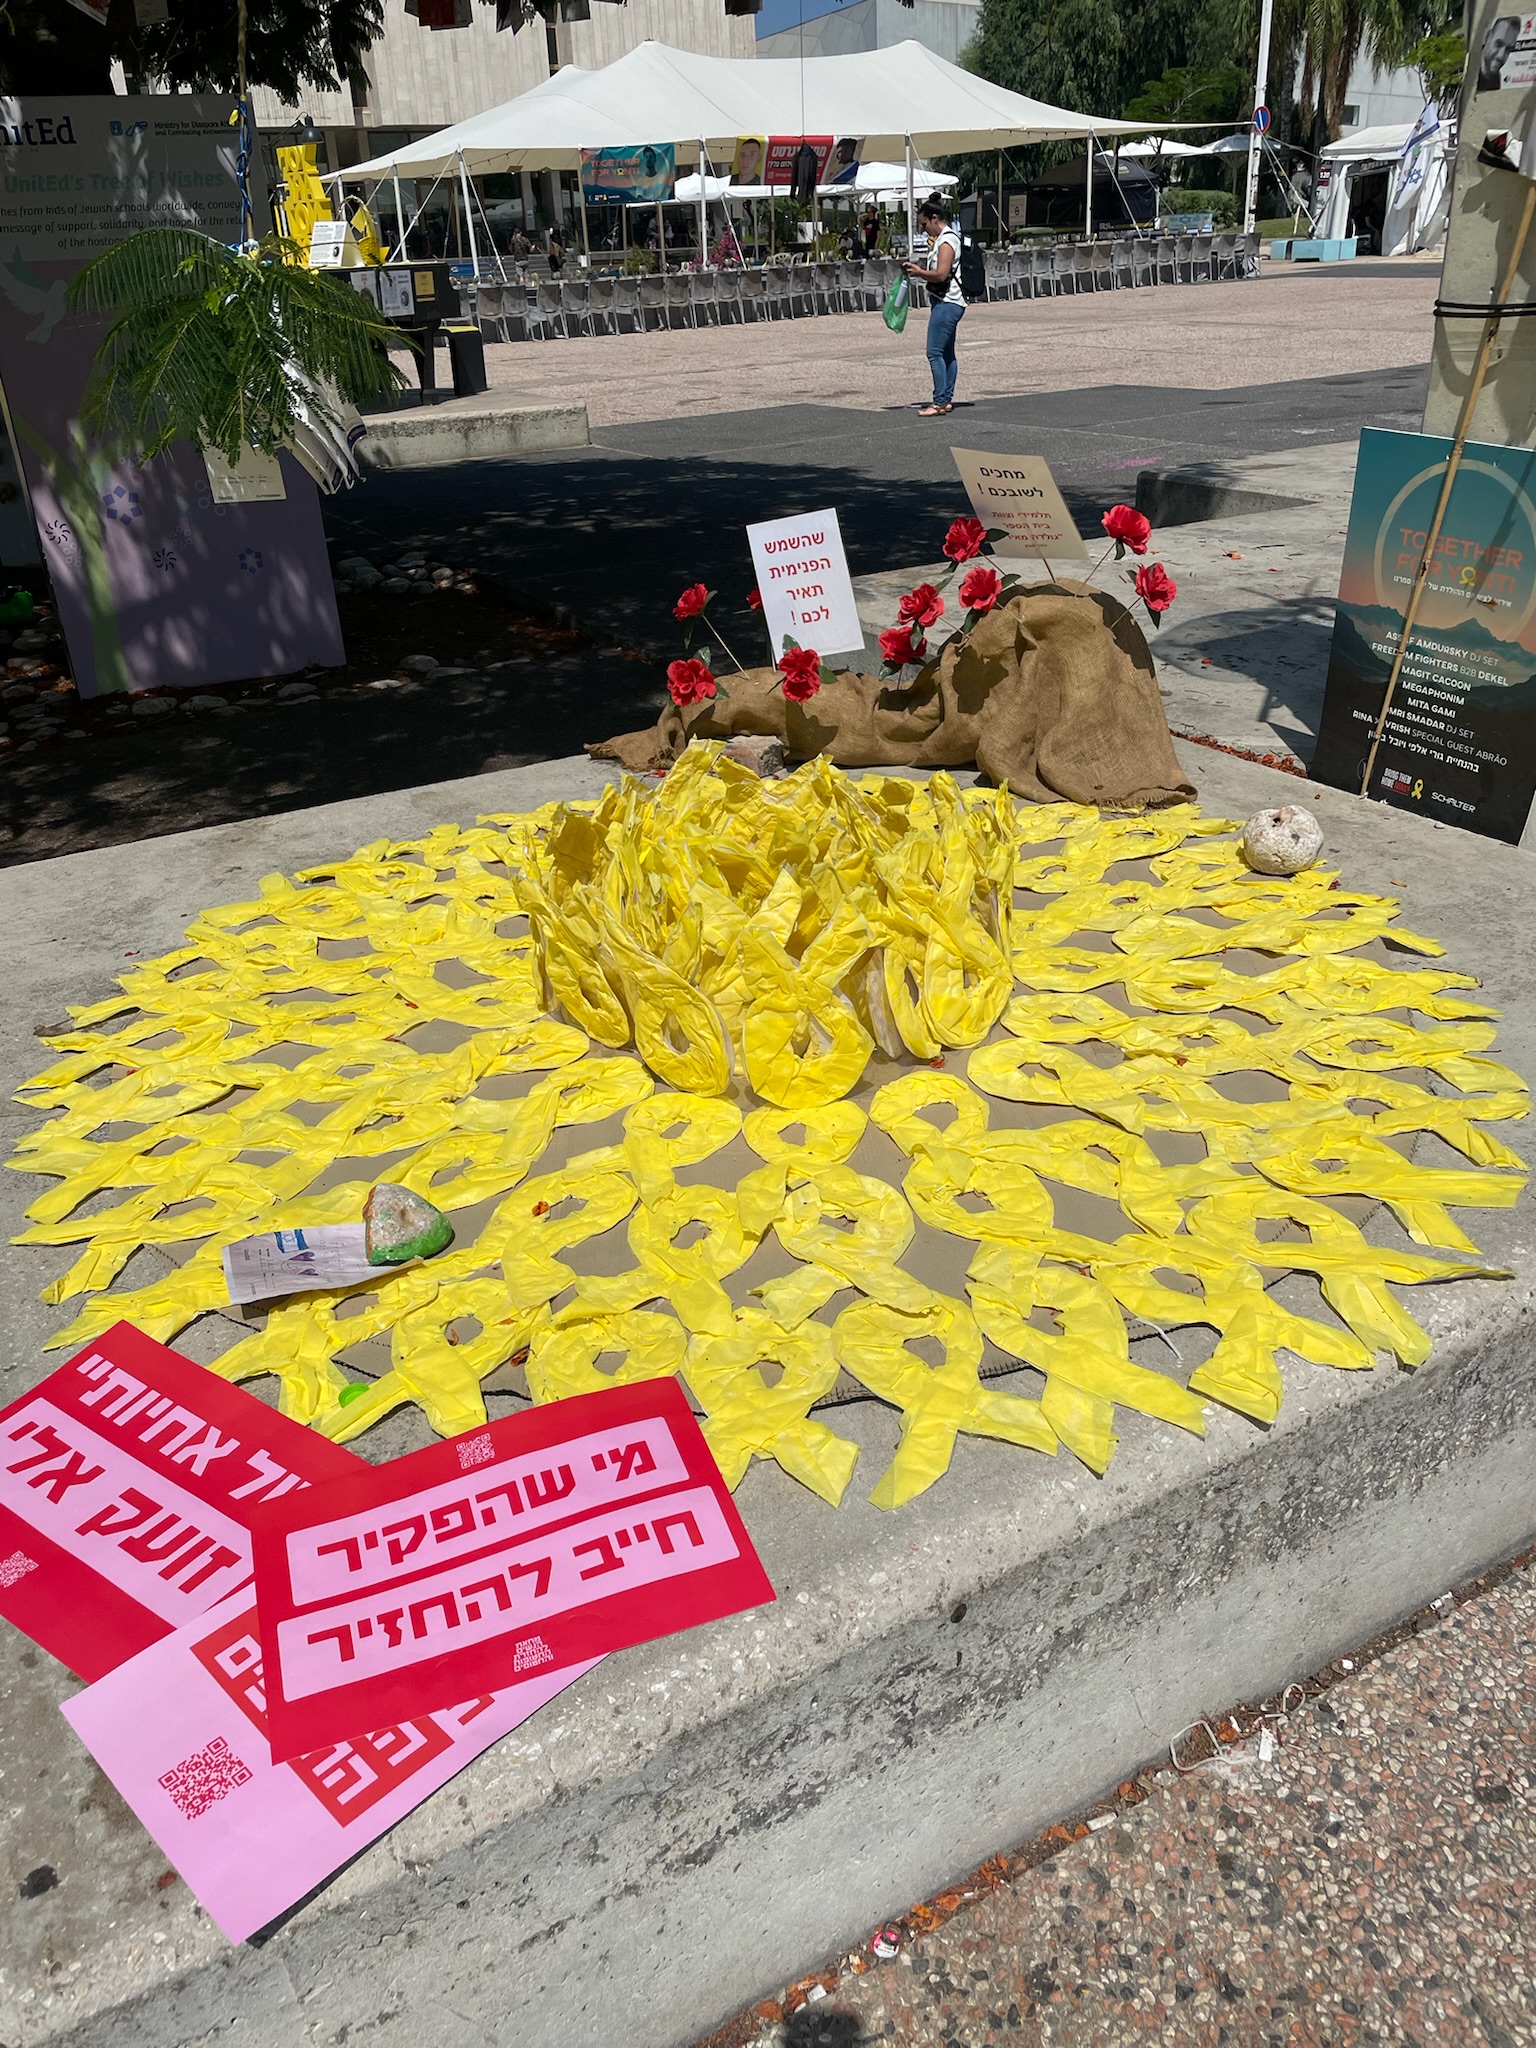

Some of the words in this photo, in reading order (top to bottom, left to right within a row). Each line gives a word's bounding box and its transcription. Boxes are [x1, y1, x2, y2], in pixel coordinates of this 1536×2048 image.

[154, 121, 179, 129] Ministry
[192, 120, 218, 129] Diaspora
[168, 128, 201, 136] Combating
[591, 158, 640, 167] TOGETHER
[591, 168, 610, 176] FOR
[5, 173, 84, 193] UnitEd's
[92, 173, 130, 190] Tree
[160, 170, 225, 189] Wishes
[20, 205, 43, 218] from
[45, 205, 65, 215] kids
[68, 204, 78, 215] of
[80, 203, 113, 213] Jewish
[114, 202, 151, 213] schools
[0, 223, 42, 235] message
[45, 222, 55, 233] of
[56, 221, 97, 232] support,
[99, 218, 147, 230] solidarity,
[148, 217, 166, 227] and
[169, 217, 192, 228] hope
[194, 216, 207, 228] for
[209, 215, 224, 225] the
[58, 238, 67, 249] of
[70, 237, 85, 247] the
[979, 467, 1025, 479] מחכים
[988, 486, 1044, 497] לשובכם
[1017, 511, 1052, 519] תלמידי
[764, 532, 824, 554] שהשמש
[769, 557, 831, 579] הפנימית
[786, 584, 824, 600] תאיר
[1428, 581, 1438, 591] של
[801, 605, 830, 623] לכם
[1386, 631, 1415, 644] ASSF
[1416, 639, 1469, 658] AMDURSKY
[1469, 652, 1481, 662] DJ
[1482, 656, 1499, 666] SET
[1371, 642, 1414, 660] FREEDM
[1414, 654, 1459, 672] FIGHTERS
[1459, 666, 1477, 677] B2B
[1477, 670, 1509, 686] DEKEL
[1401, 665, 1431, 680] MAGIT
[1432, 673, 1472, 691] CACOON
[1402, 680, 1465, 706] MEGAPHONIM
[1407, 697, 1430, 711] MITA
[1431, 704, 1456, 719] GAMI
[1387, 706, 1406, 718] MRI
[1406, 711, 1446, 731] SMADAR
[1446, 724, 1457, 735] DJ
[1458, 728, 1475, 740] SET
[1352, 709, 1373, 724] RINA
[1411, 728, 1445, 746] SPECIAL
[1446, 740, 1475, 755] GUEST
[1475, 749, 1508, 766] ABRÃO
[1388, 734, 1407, 749] ויובל
[1408, 742, 1428, 756] אלפי
[1429, 749, 1444, 761] גורי
[1431, 792, 1476, 813] SCHALTER
[76, 1354, 241, 1480] אחיותיי
[5, 1419, 105, 1505] אלי
[592, 1439, 658, 1482] מי
[317, 1462, 576, 1573] שהפקיר
[76, 1489, 242, 1595] זועק
[571, 1510, 705, 1581] חייב
[306, 1556, 553, 1663] להחזיר
[515, 1635, 542, 1649] מחאת
